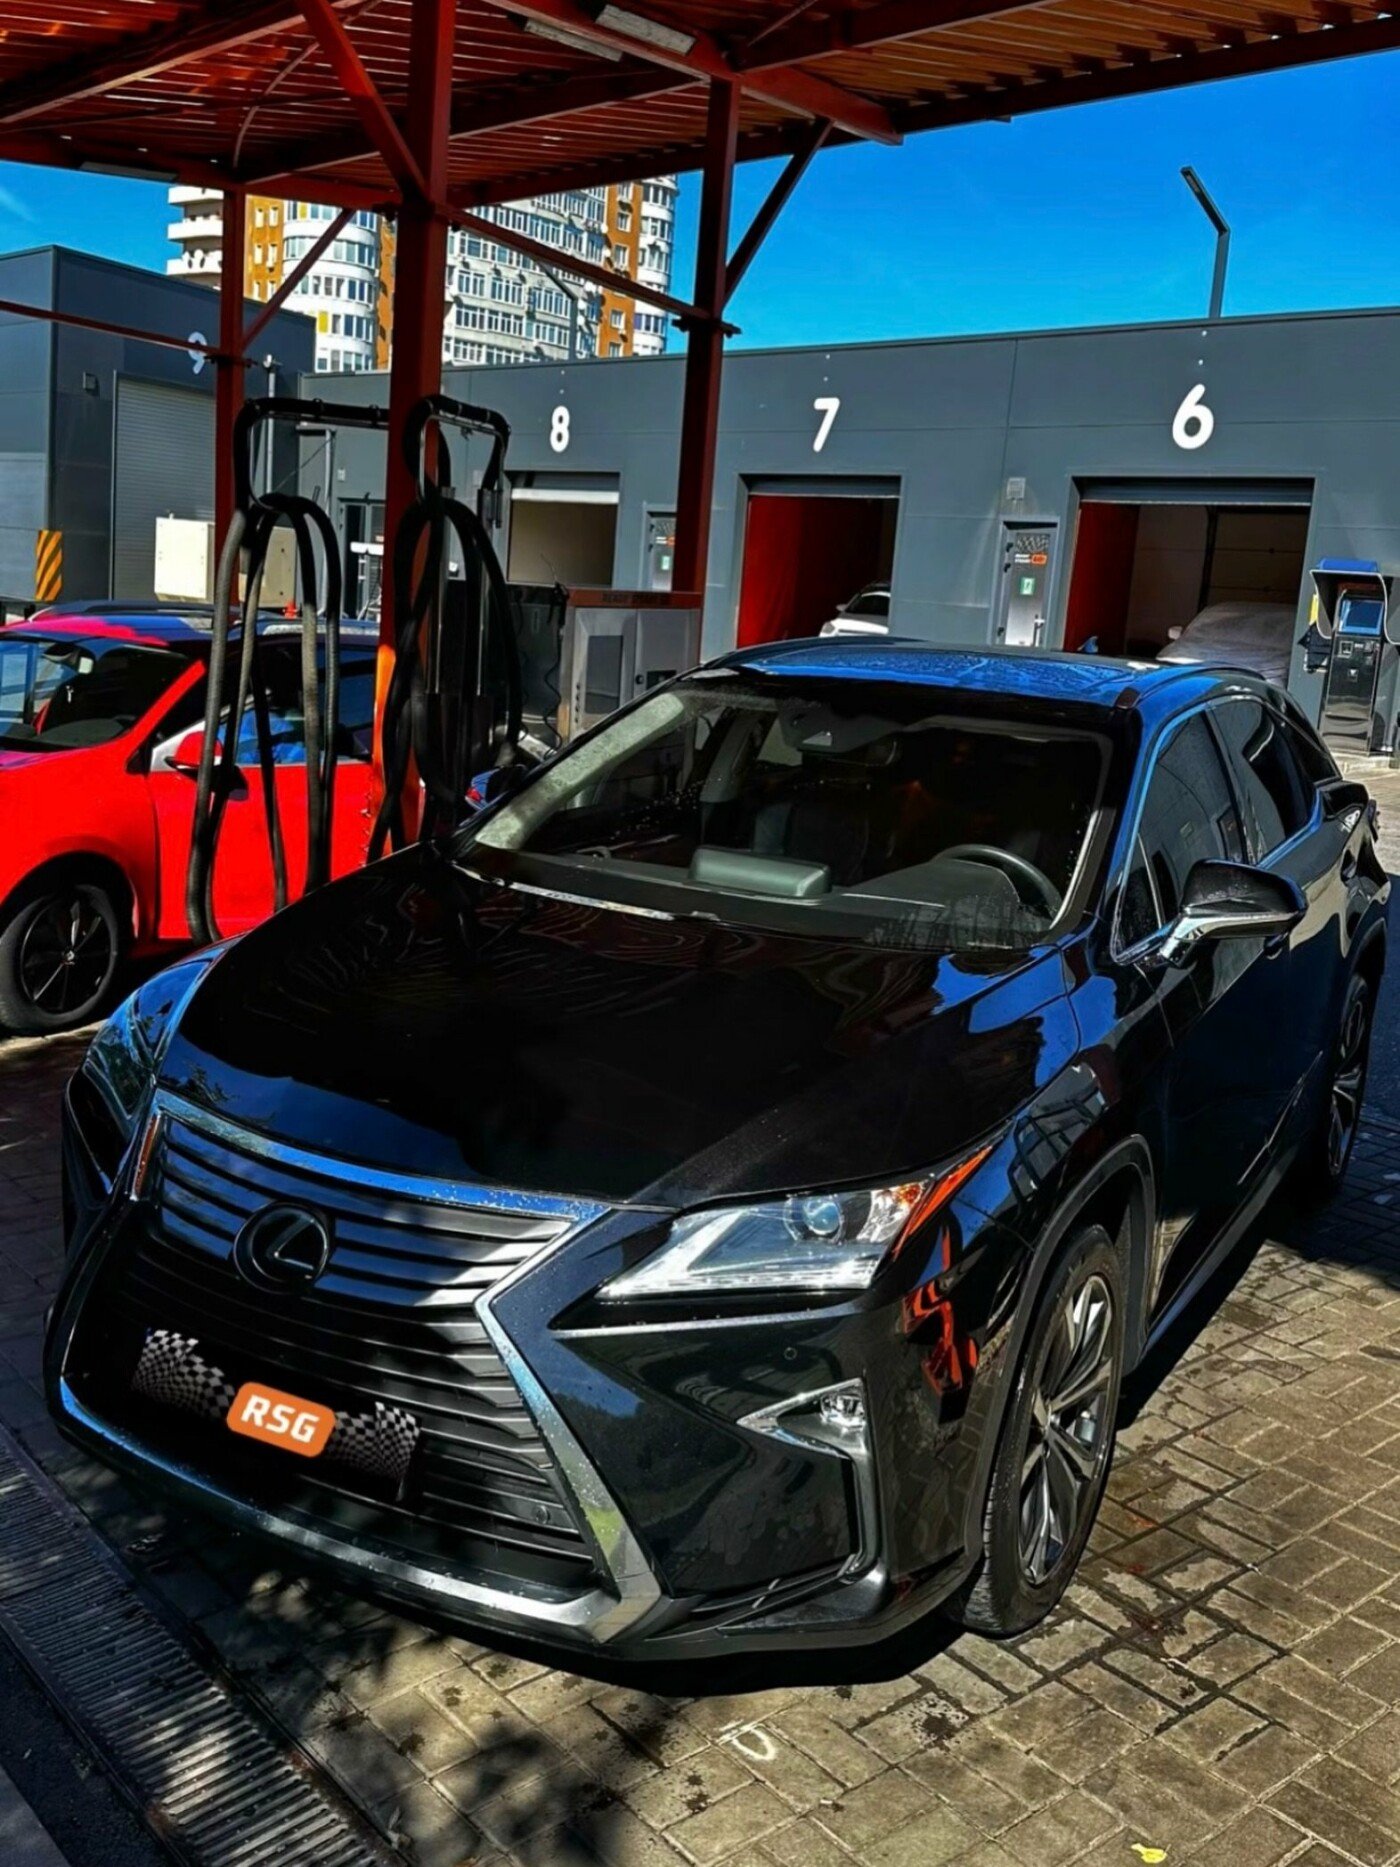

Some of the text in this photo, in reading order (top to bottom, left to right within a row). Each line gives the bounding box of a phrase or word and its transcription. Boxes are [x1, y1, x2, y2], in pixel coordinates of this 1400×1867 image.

[188, 331, 208, 374] 9
[550, 405, 570, 453] 8
[813, 397, 841, 453] 7
[1172, 383, 1215, 450] 6
[240, 1394, 320, 1443] RSG
